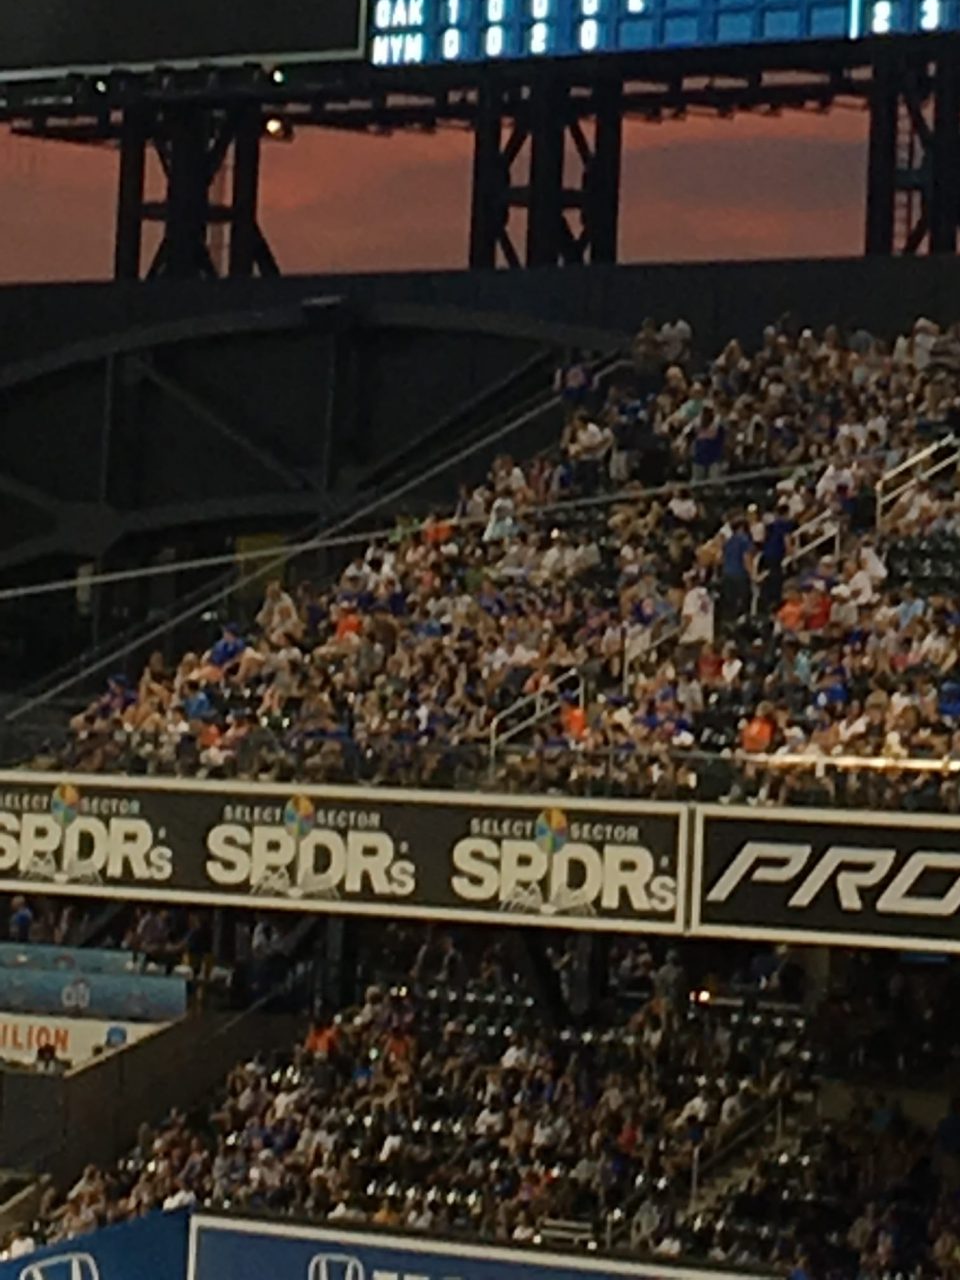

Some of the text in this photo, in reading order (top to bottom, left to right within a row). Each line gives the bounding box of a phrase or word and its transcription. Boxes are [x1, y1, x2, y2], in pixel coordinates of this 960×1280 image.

[530, 22, 547, 53] 2
[0, 793, 49, 810] ELECT
[470, 817, 640, 841] SELECT SECTOR
